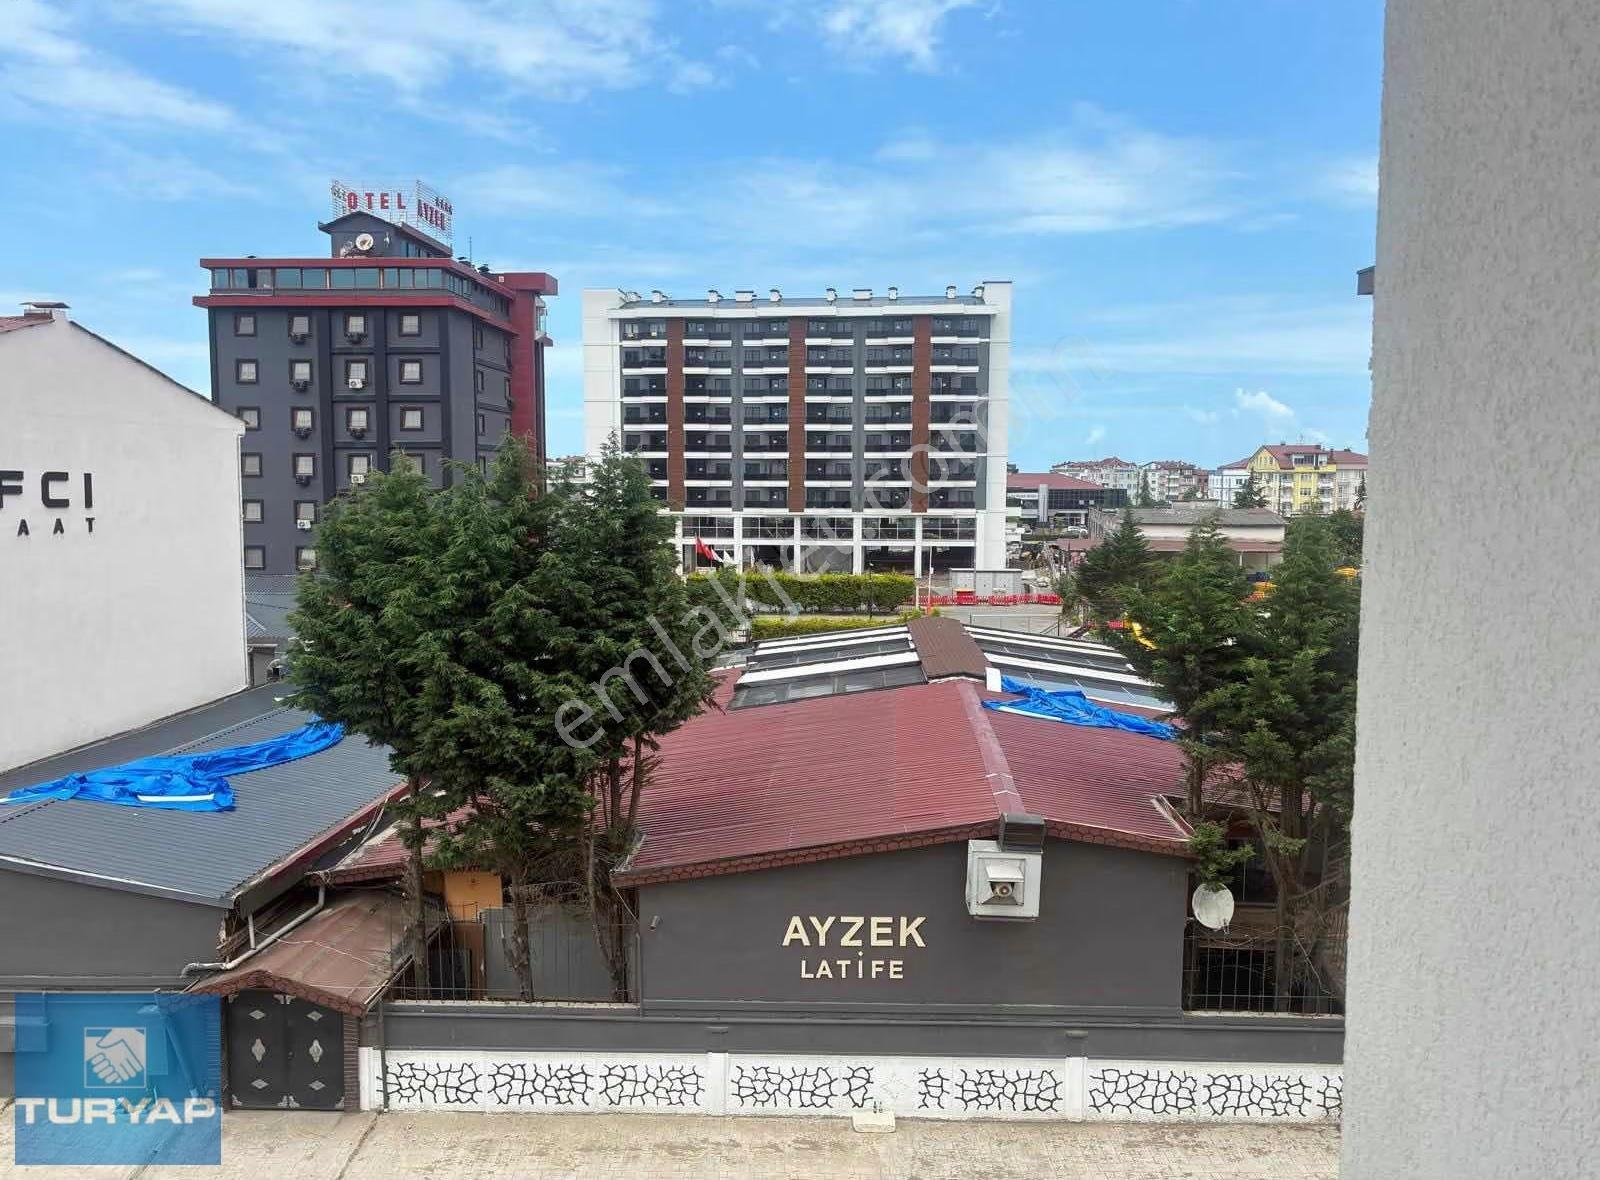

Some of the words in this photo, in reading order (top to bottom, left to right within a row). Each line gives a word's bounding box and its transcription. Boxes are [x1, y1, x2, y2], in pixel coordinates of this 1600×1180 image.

[347, 192, 406, 210] OTEL
[782, 915, 927, 948] AYZEK
[800, 950, 904, 979] LATİFE
